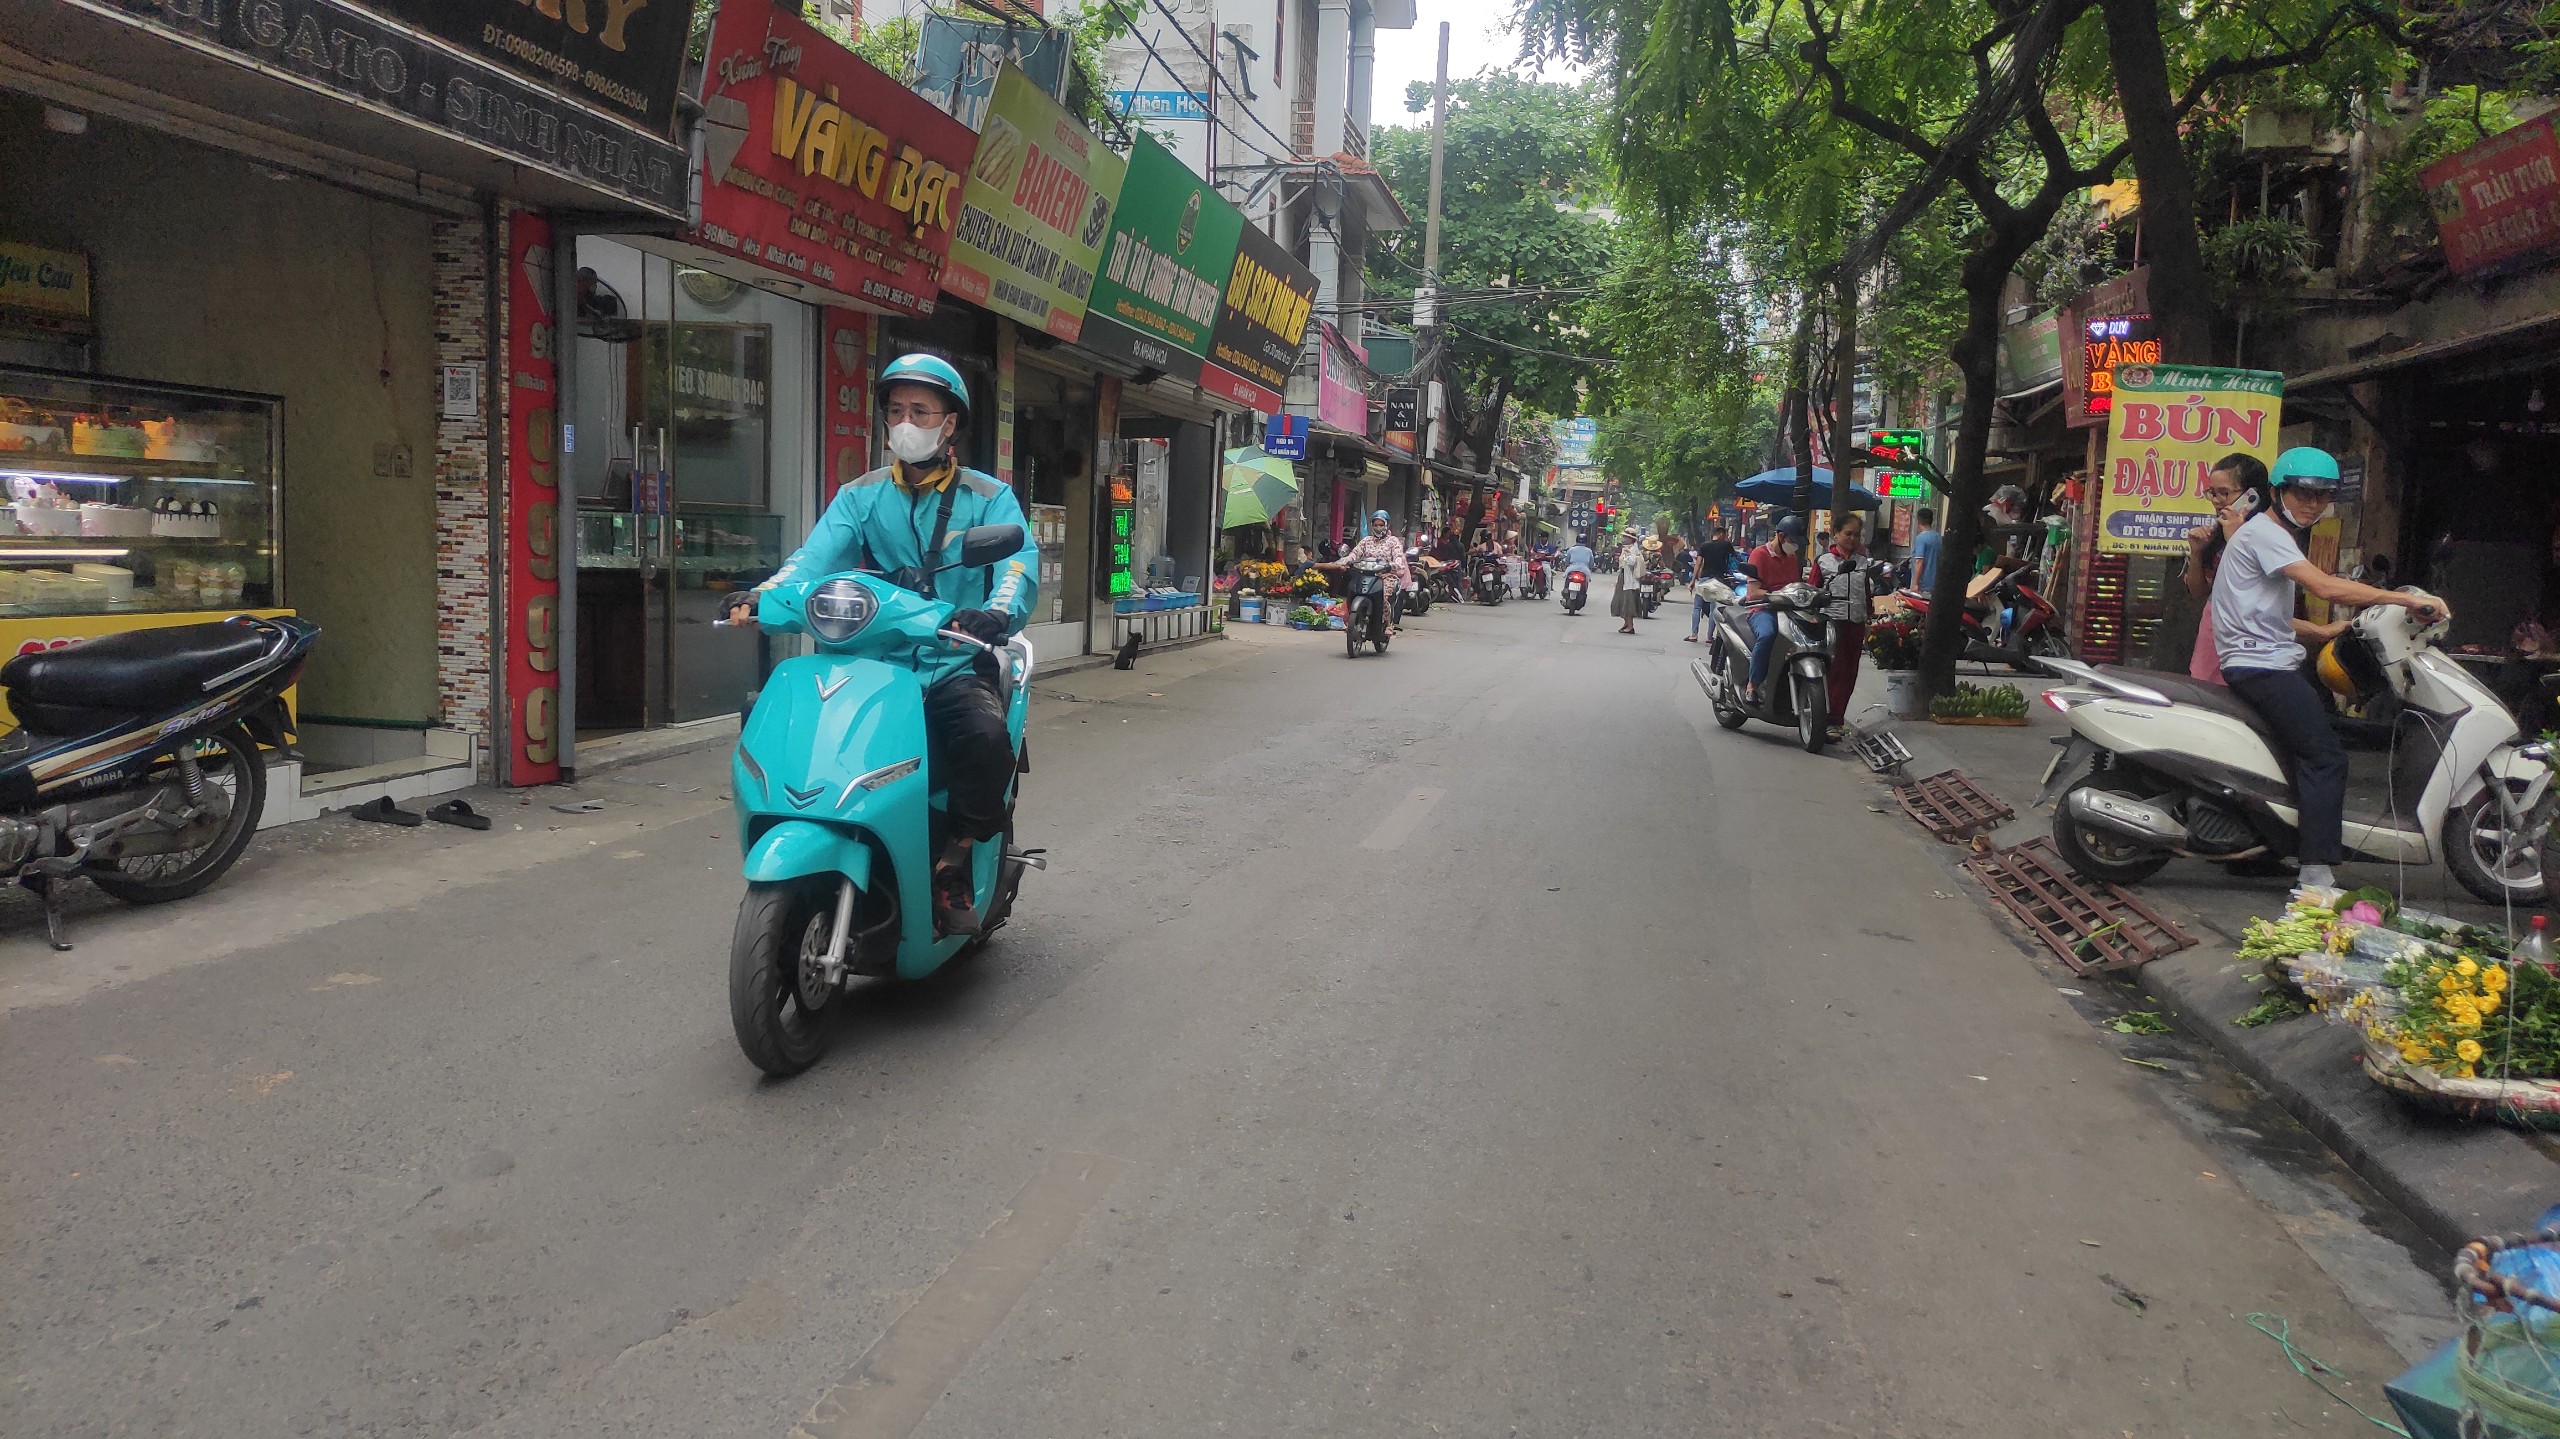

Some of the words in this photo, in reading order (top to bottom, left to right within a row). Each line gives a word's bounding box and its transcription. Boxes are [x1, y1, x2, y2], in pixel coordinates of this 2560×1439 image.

[773, 76, 888, 200] VÀNG
[884, 144, 960, 240] BẠC
[1012, 141, 1091, 240] BAKERY
[956, 201, 996, 252] CHUYÊN
[1106, 227, 1135, 284] TRÀ
[1125, 235, 1152, 294] TÂN
[1171, 264, 1196, 316] THÁI
[1226, 250, 1256, 321] GẠO
[2109, 320, 2129, 335] DUY
[2089, 335, 2157, 369] VÀNG
[2155, 370, 2212, 389] Minh
[838, 385, 860, 414] 98
[1390, 402, 1414, 410] NAM
[1397, 410, 1406, 419] &
[2119, 395, 2267, 448] BÚN
[2112, 447, 2189, 508] ĐẬU
[2135, 513, 2163, 526] NHẬN
[2166, 515, 2189, 525] SHIP
[2148, 526, 2176, 538] 097
[79, 769, 124, 789] YAMAHA
